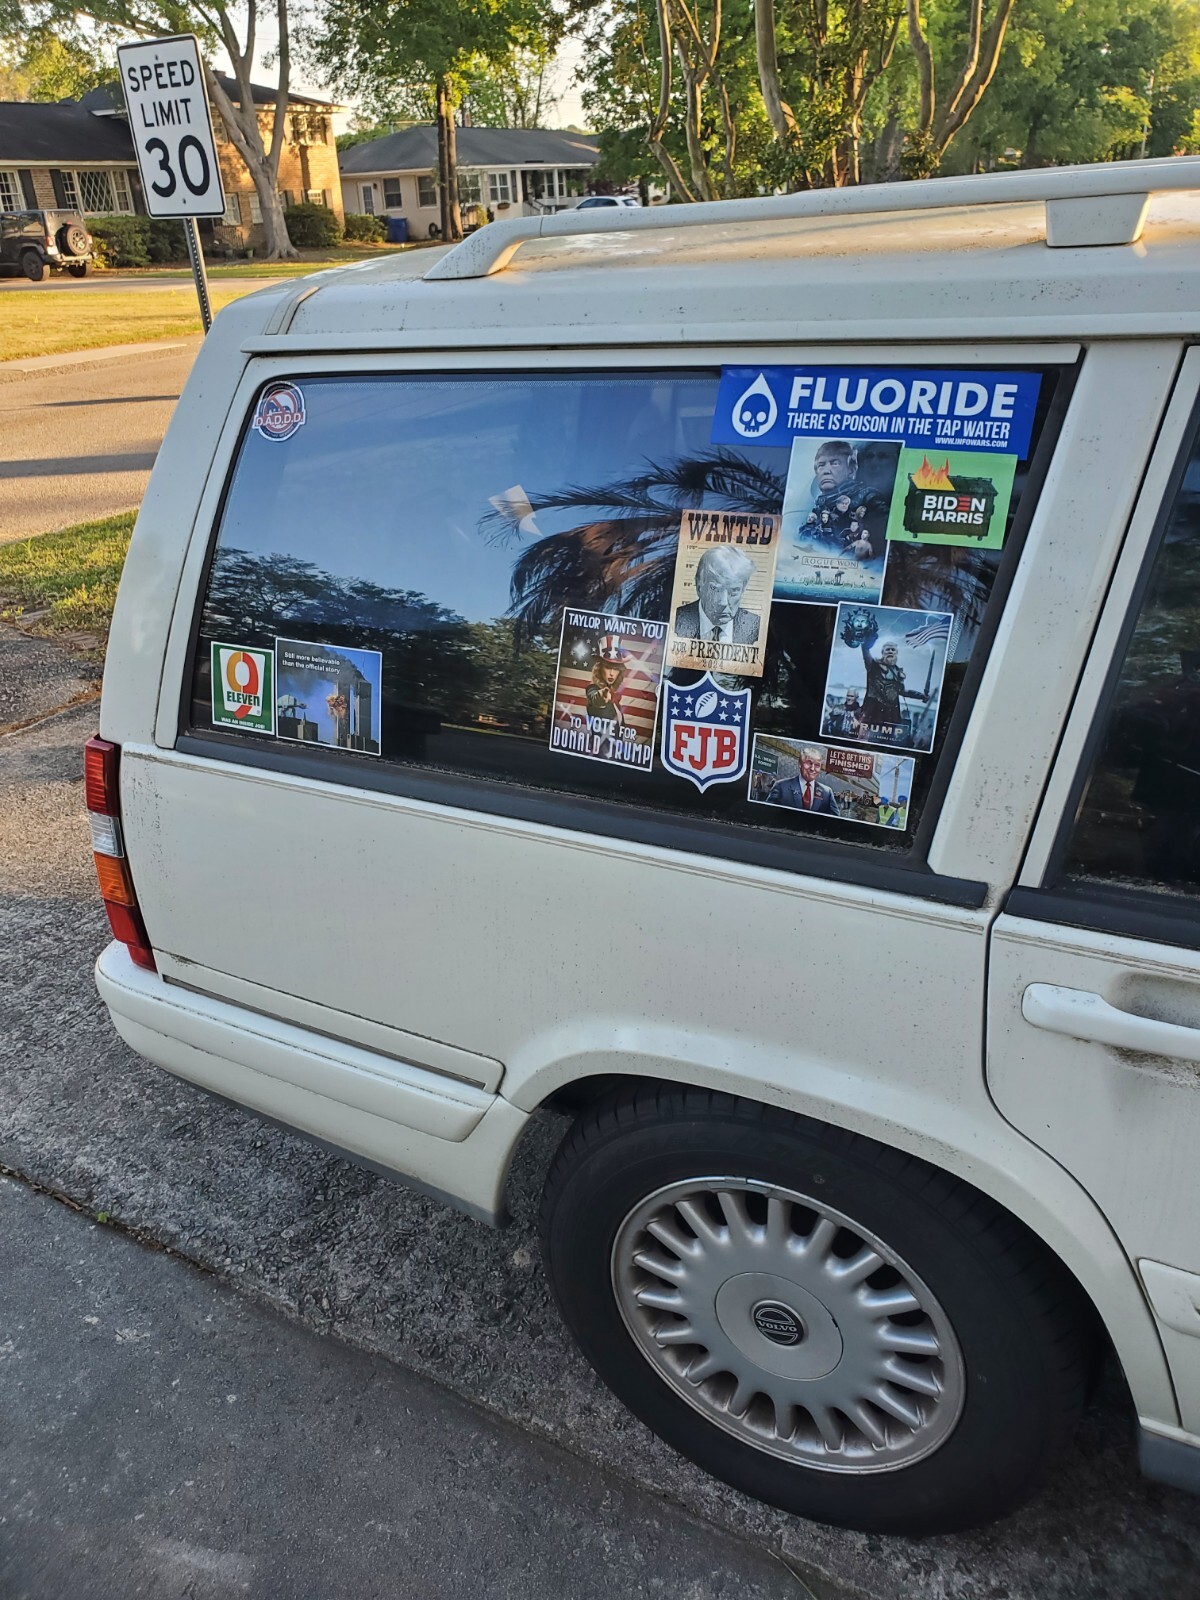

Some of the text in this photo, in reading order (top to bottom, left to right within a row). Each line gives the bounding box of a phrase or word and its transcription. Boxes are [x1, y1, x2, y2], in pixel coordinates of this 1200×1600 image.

[127, 59, 195, 93] SPEED
[140, 98, 191, 128] LIMIT
[144, 134, 210, 198] 30
[788, 376, 1019, 419] FLUORIDE
[786, 412, 1011, 440] THERE IS POISON IN THE TAP WATER
[935, 437, 1008, 448] WWW.INFOWARS.COM
[921, 509, 984, 525] HARRIS
[923, 495, 987, 514] BIDEN
[687, 512, 774, 545] WANTED
[568, 612, 664, 640] TAYLOR WANTS YOU
[282, 659, 295, 667] than
[305, 663, 325, 672] official
[311, 655, 341, 666] believable
[688, 640, 760, 666] PRESIDENT
[570, 714, 638, 741] TO VOTE FOR
[553, 726, 651, 765] DONALD TRUMP
[672, 724, 736, 770] FJB
[829, 750, 846, 760] LET'S
[858, 755, 873, 765] THIS
[829, 758, 871, 771] FINISHED
[757, 1320, 797, 1331] VOLVO
